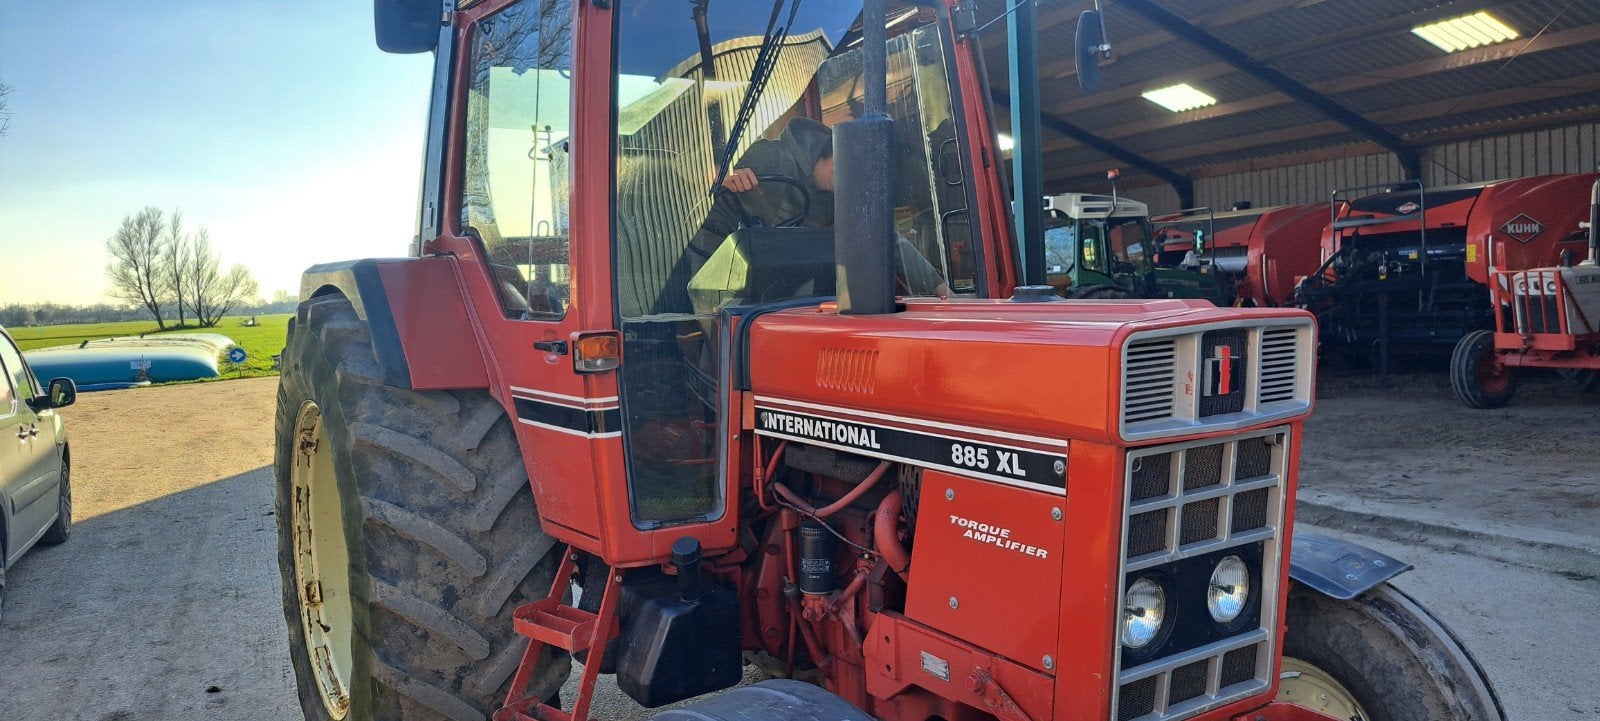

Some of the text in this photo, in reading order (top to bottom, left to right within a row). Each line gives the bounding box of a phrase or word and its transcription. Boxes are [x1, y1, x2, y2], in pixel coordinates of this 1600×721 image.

[1507, 223, 1539, 234] KUHN
[951, 443, 989, 469] 885
[996, 450, 1026, 476] XL
[950, 515, 1010, 538] TORQUE
[963, 530, 1048, 558] AMPLIFIER
